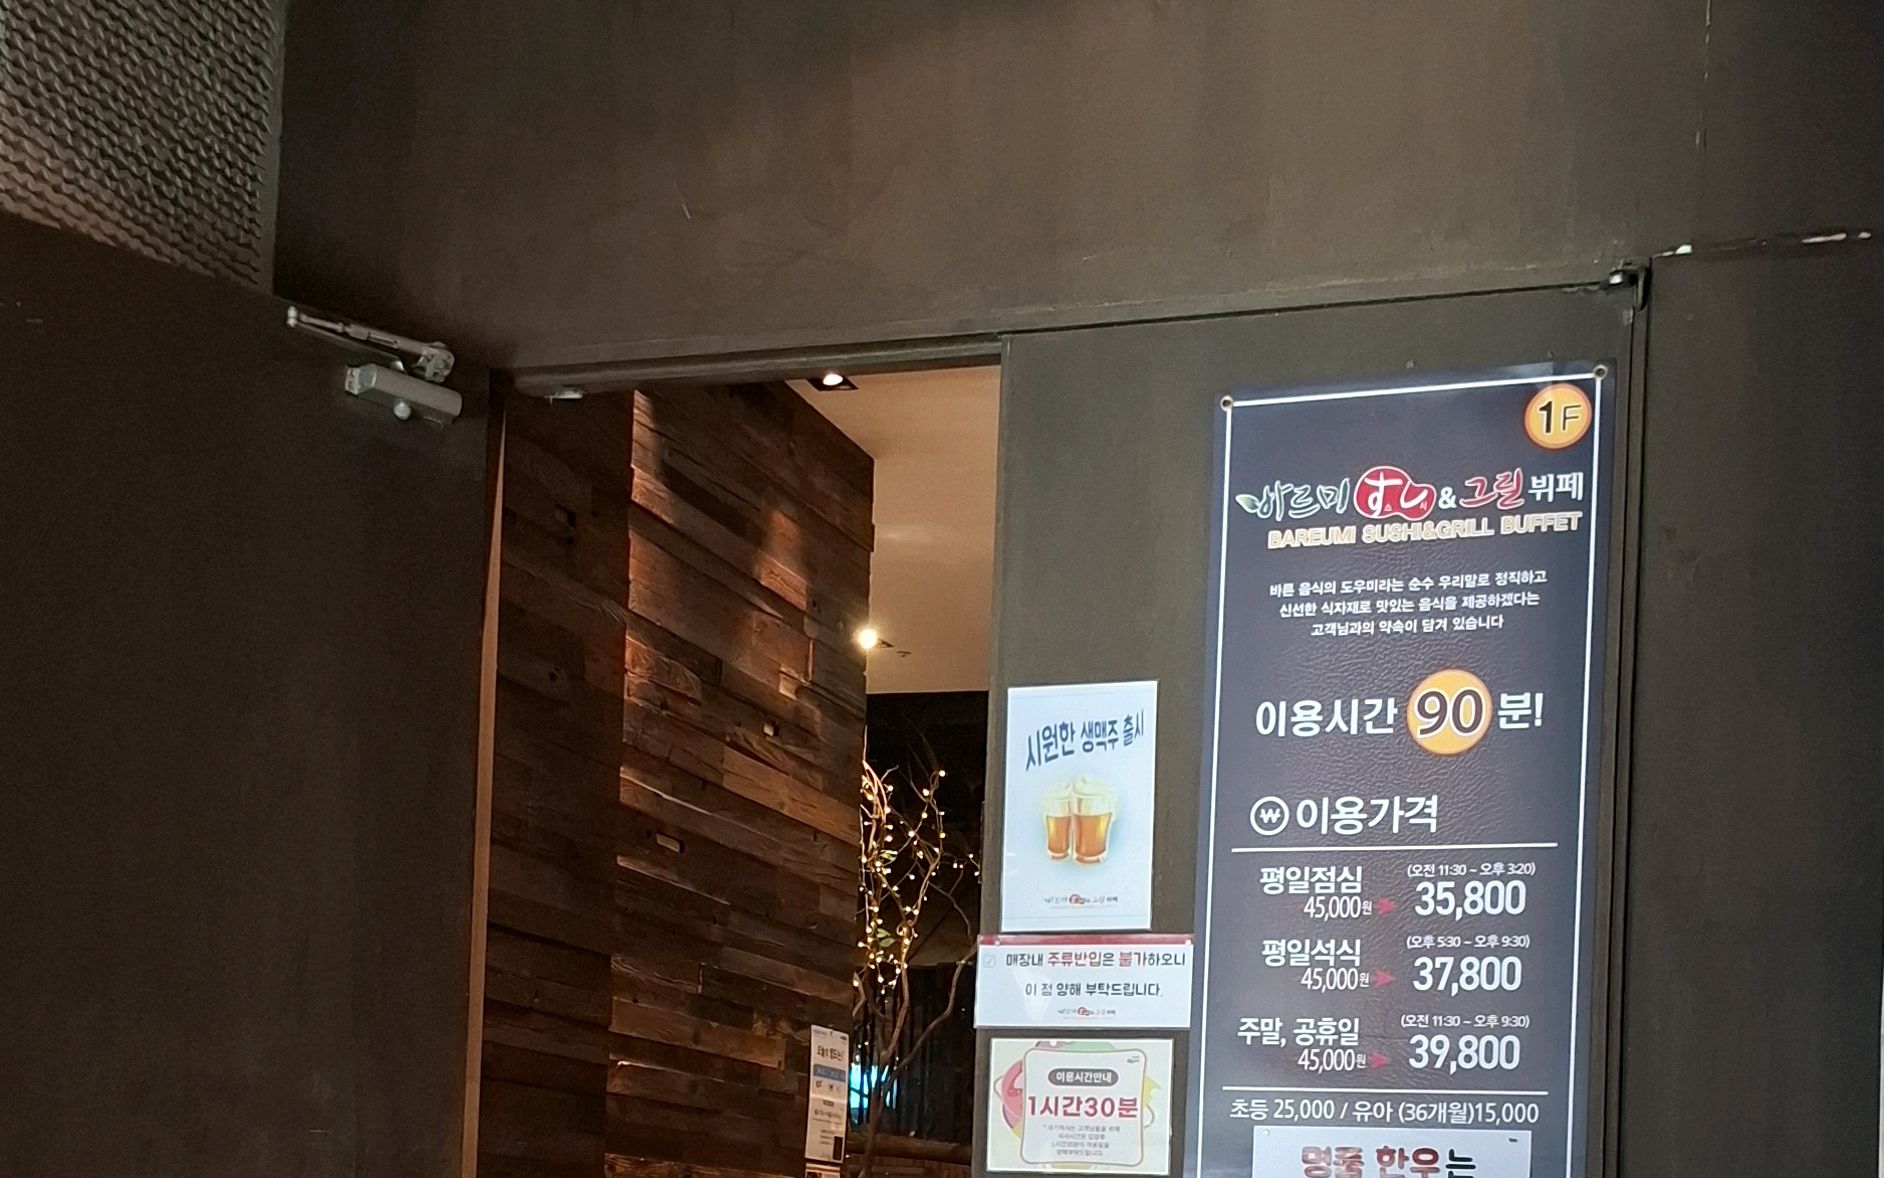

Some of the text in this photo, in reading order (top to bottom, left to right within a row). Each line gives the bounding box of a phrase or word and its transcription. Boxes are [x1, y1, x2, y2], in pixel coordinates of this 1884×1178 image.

[1538, 401, 1581, 433] 1F
[1439, 487, 1456, 508] &
[1460, 468, 1523, 508] 그릴
[1528, 472, 1583, 503] 뷔페
[1268, 512, 1583, 549] BAREUMI SUSHI&GRILL BUFFET
[1270, 570, 1547, 597] 바른 음식의 도우미라는 순수 우리말로 정직하고
[1280, 592, 1539, 617] 신선한 식자재로 맛있는 음식을 제공하겠다는
[1312, 615, 1503, 636] 고객님과의 약속이 담겨 있습니다
[1256, 688, 1544, 738] 이용시간 90 분!
[1025, 709, 1144, 771] 시원한 생맥주 출시
[1297, 794, 1438, 834] 이용가격
[1259, 866, 1362, 895] 평일점심
[1407, 864, 1435, 877] (오전
[1480, 863, 1505, 875] 오후
[1303, 880, 1526, 921] 45,000원 35,800
[1006, 951, 1185, 967] 매장내 주류반입은 불가하오니
[1262, 939, 1361, 967] 평일석식
[1407, 936, 1434, 949] (오후
[1474, 936, 1499, 948] 오후
[1502, 935, 1530, 949] 9:30)
[1025, 983, 1037, 996] 이
[1042, 983, 1052, 996] 점
[1057, 983, 1081, 997] 양해
[1301, 956, 1522, 997] 45,000원 37,800
[1237, 1018, 1287, 1048] 주말,
[1293, 1017, 1359, 1046] 공휴일
[1401, 1015, 1430, 1028] (오전
[1474, 1016, 1498, 1028] 오후
[1502, 1015, 1529, 1028] 9:30)
[1298, 1034, 1520, 1075] 45,000원 39,800
[1056, 1071, 1112, 1083] 이용시간안내
[1028, 1096, 1138, 1118] 1시간30분
[1230, 1100, 1268, 1119] 초등
[1273, 1099, 1334, 1122] 25,000
[1339, 1101, 1348, 1120] /
[1352, 1101, 1393, 1121] 유아
[1302, 1146, 1364, 1178] 명품
